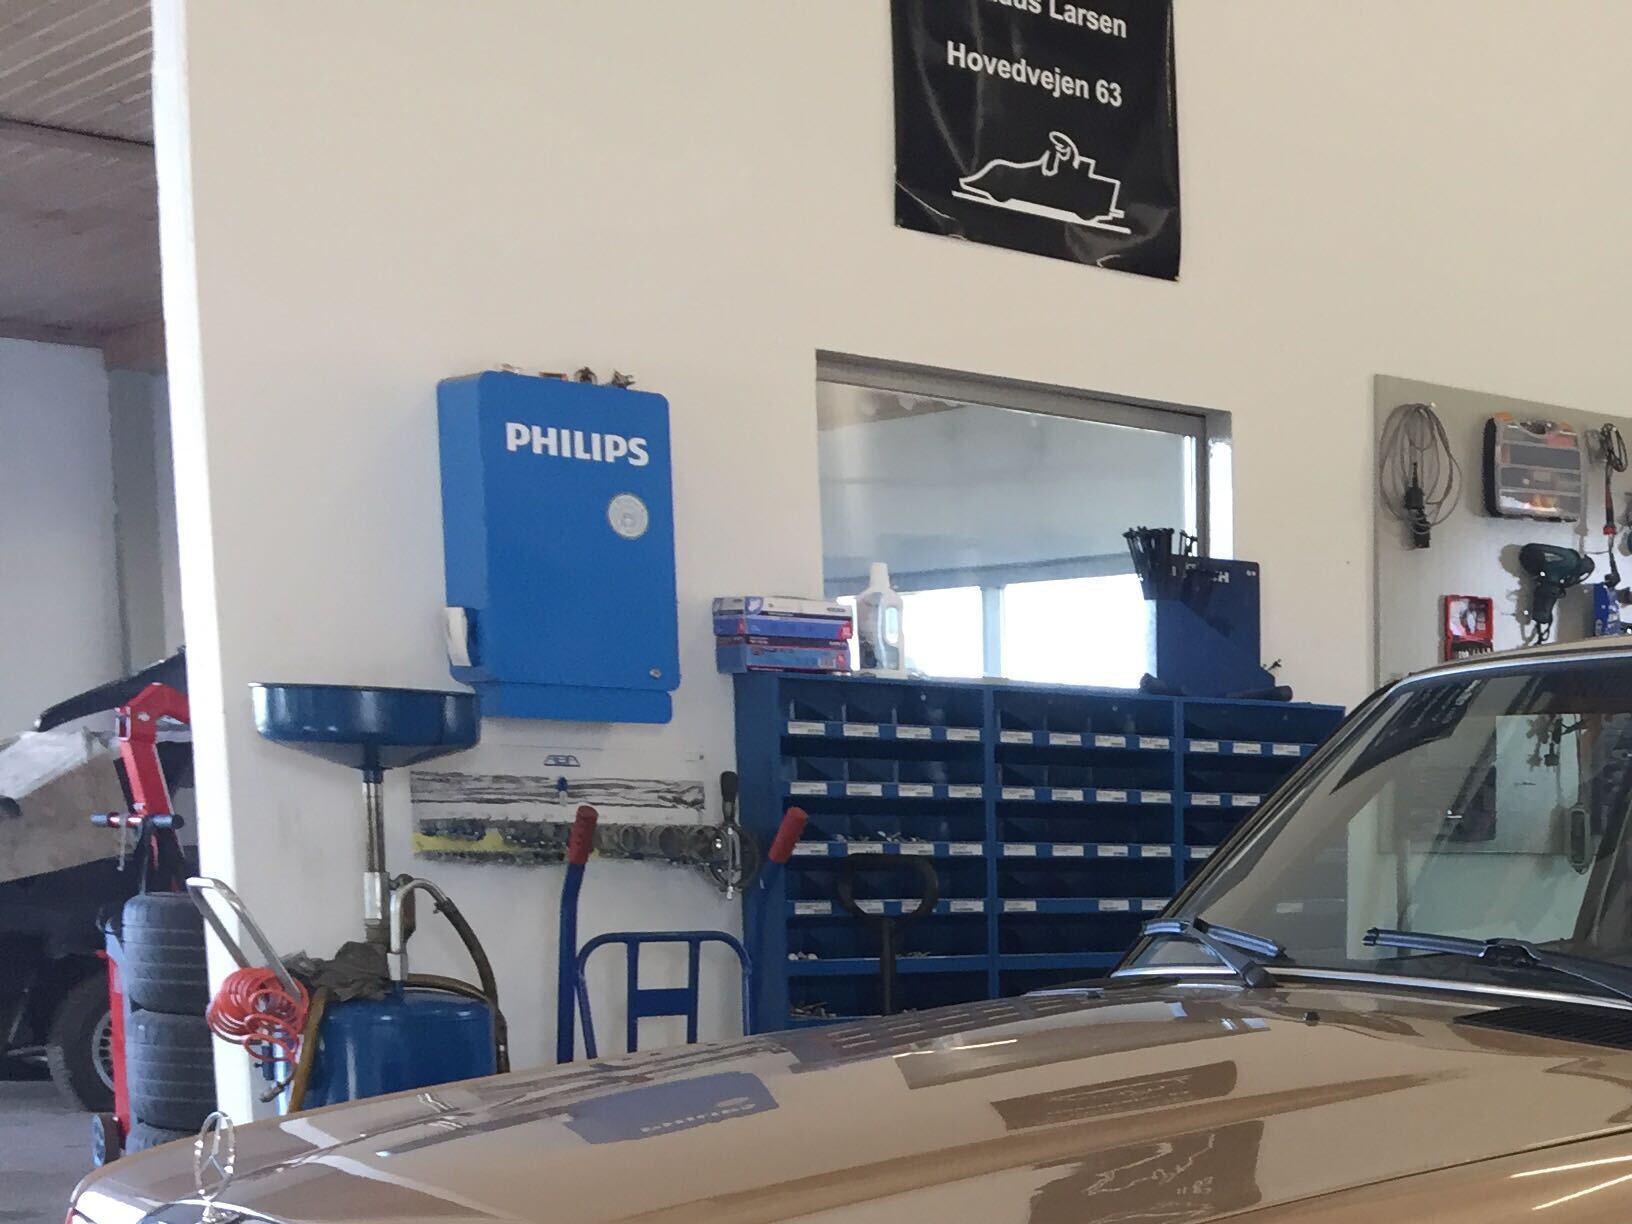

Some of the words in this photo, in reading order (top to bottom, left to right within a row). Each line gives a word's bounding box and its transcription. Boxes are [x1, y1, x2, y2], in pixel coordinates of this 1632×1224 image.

[1049, 0, 1128, 38] Larsen
[947, 40, 1091, 98] Hovedvejen
[1095, 79, 1123, 107] 63
[505, 421, 650, 467] PHILIPS
